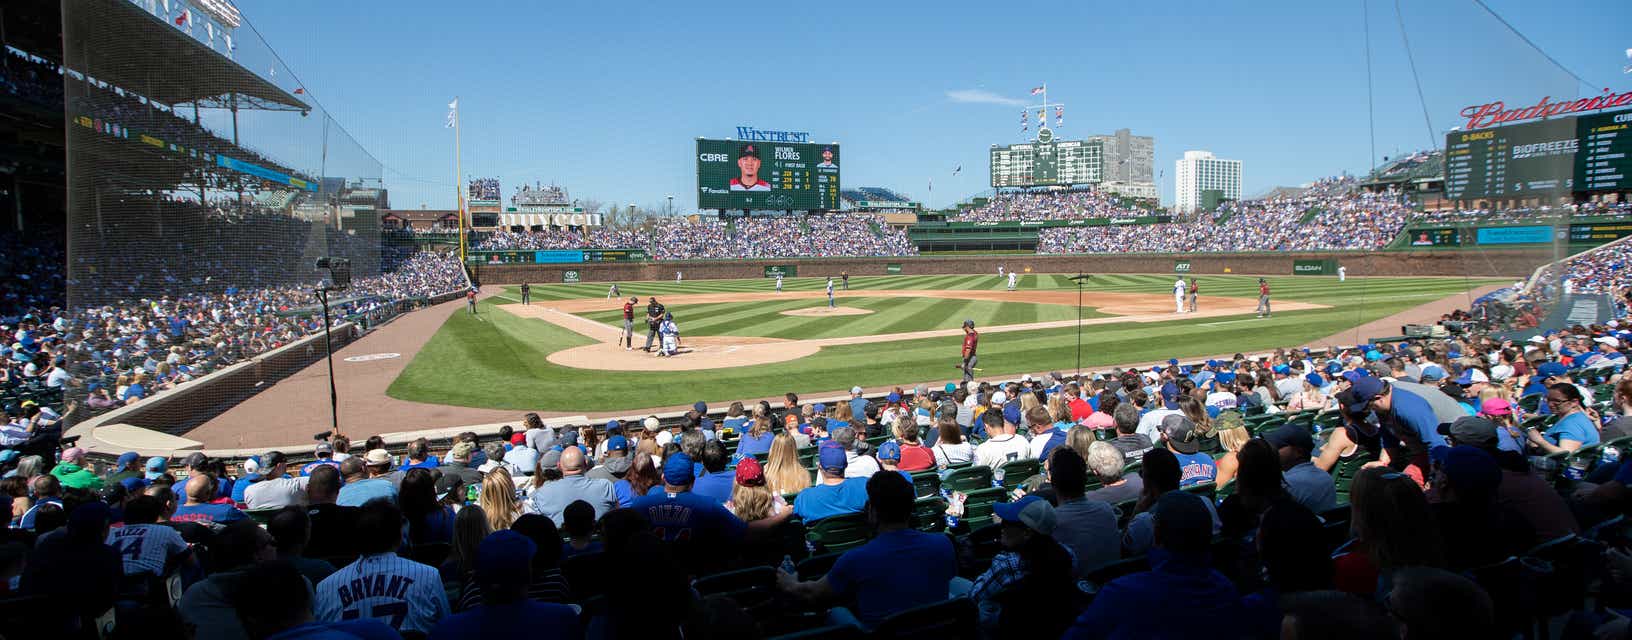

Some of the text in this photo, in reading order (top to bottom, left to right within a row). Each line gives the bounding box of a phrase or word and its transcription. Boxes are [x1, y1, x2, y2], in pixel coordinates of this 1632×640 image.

[1461, 88, 1632, 130] Budweise
[1614, 113, 1632, 122] CUB
[736, 126, 809, 143] WINTRUST
[1462, 131, 1495, 142] D-BACKS
[1513, 139, 1579, 155] BIOFREEZE
[700, 153, 729, 162] CBRE
[775, 152, 800, 160] FLORES
[338, 574, 415, 607] BRYANT
[342, 600, 409, 631] 7
